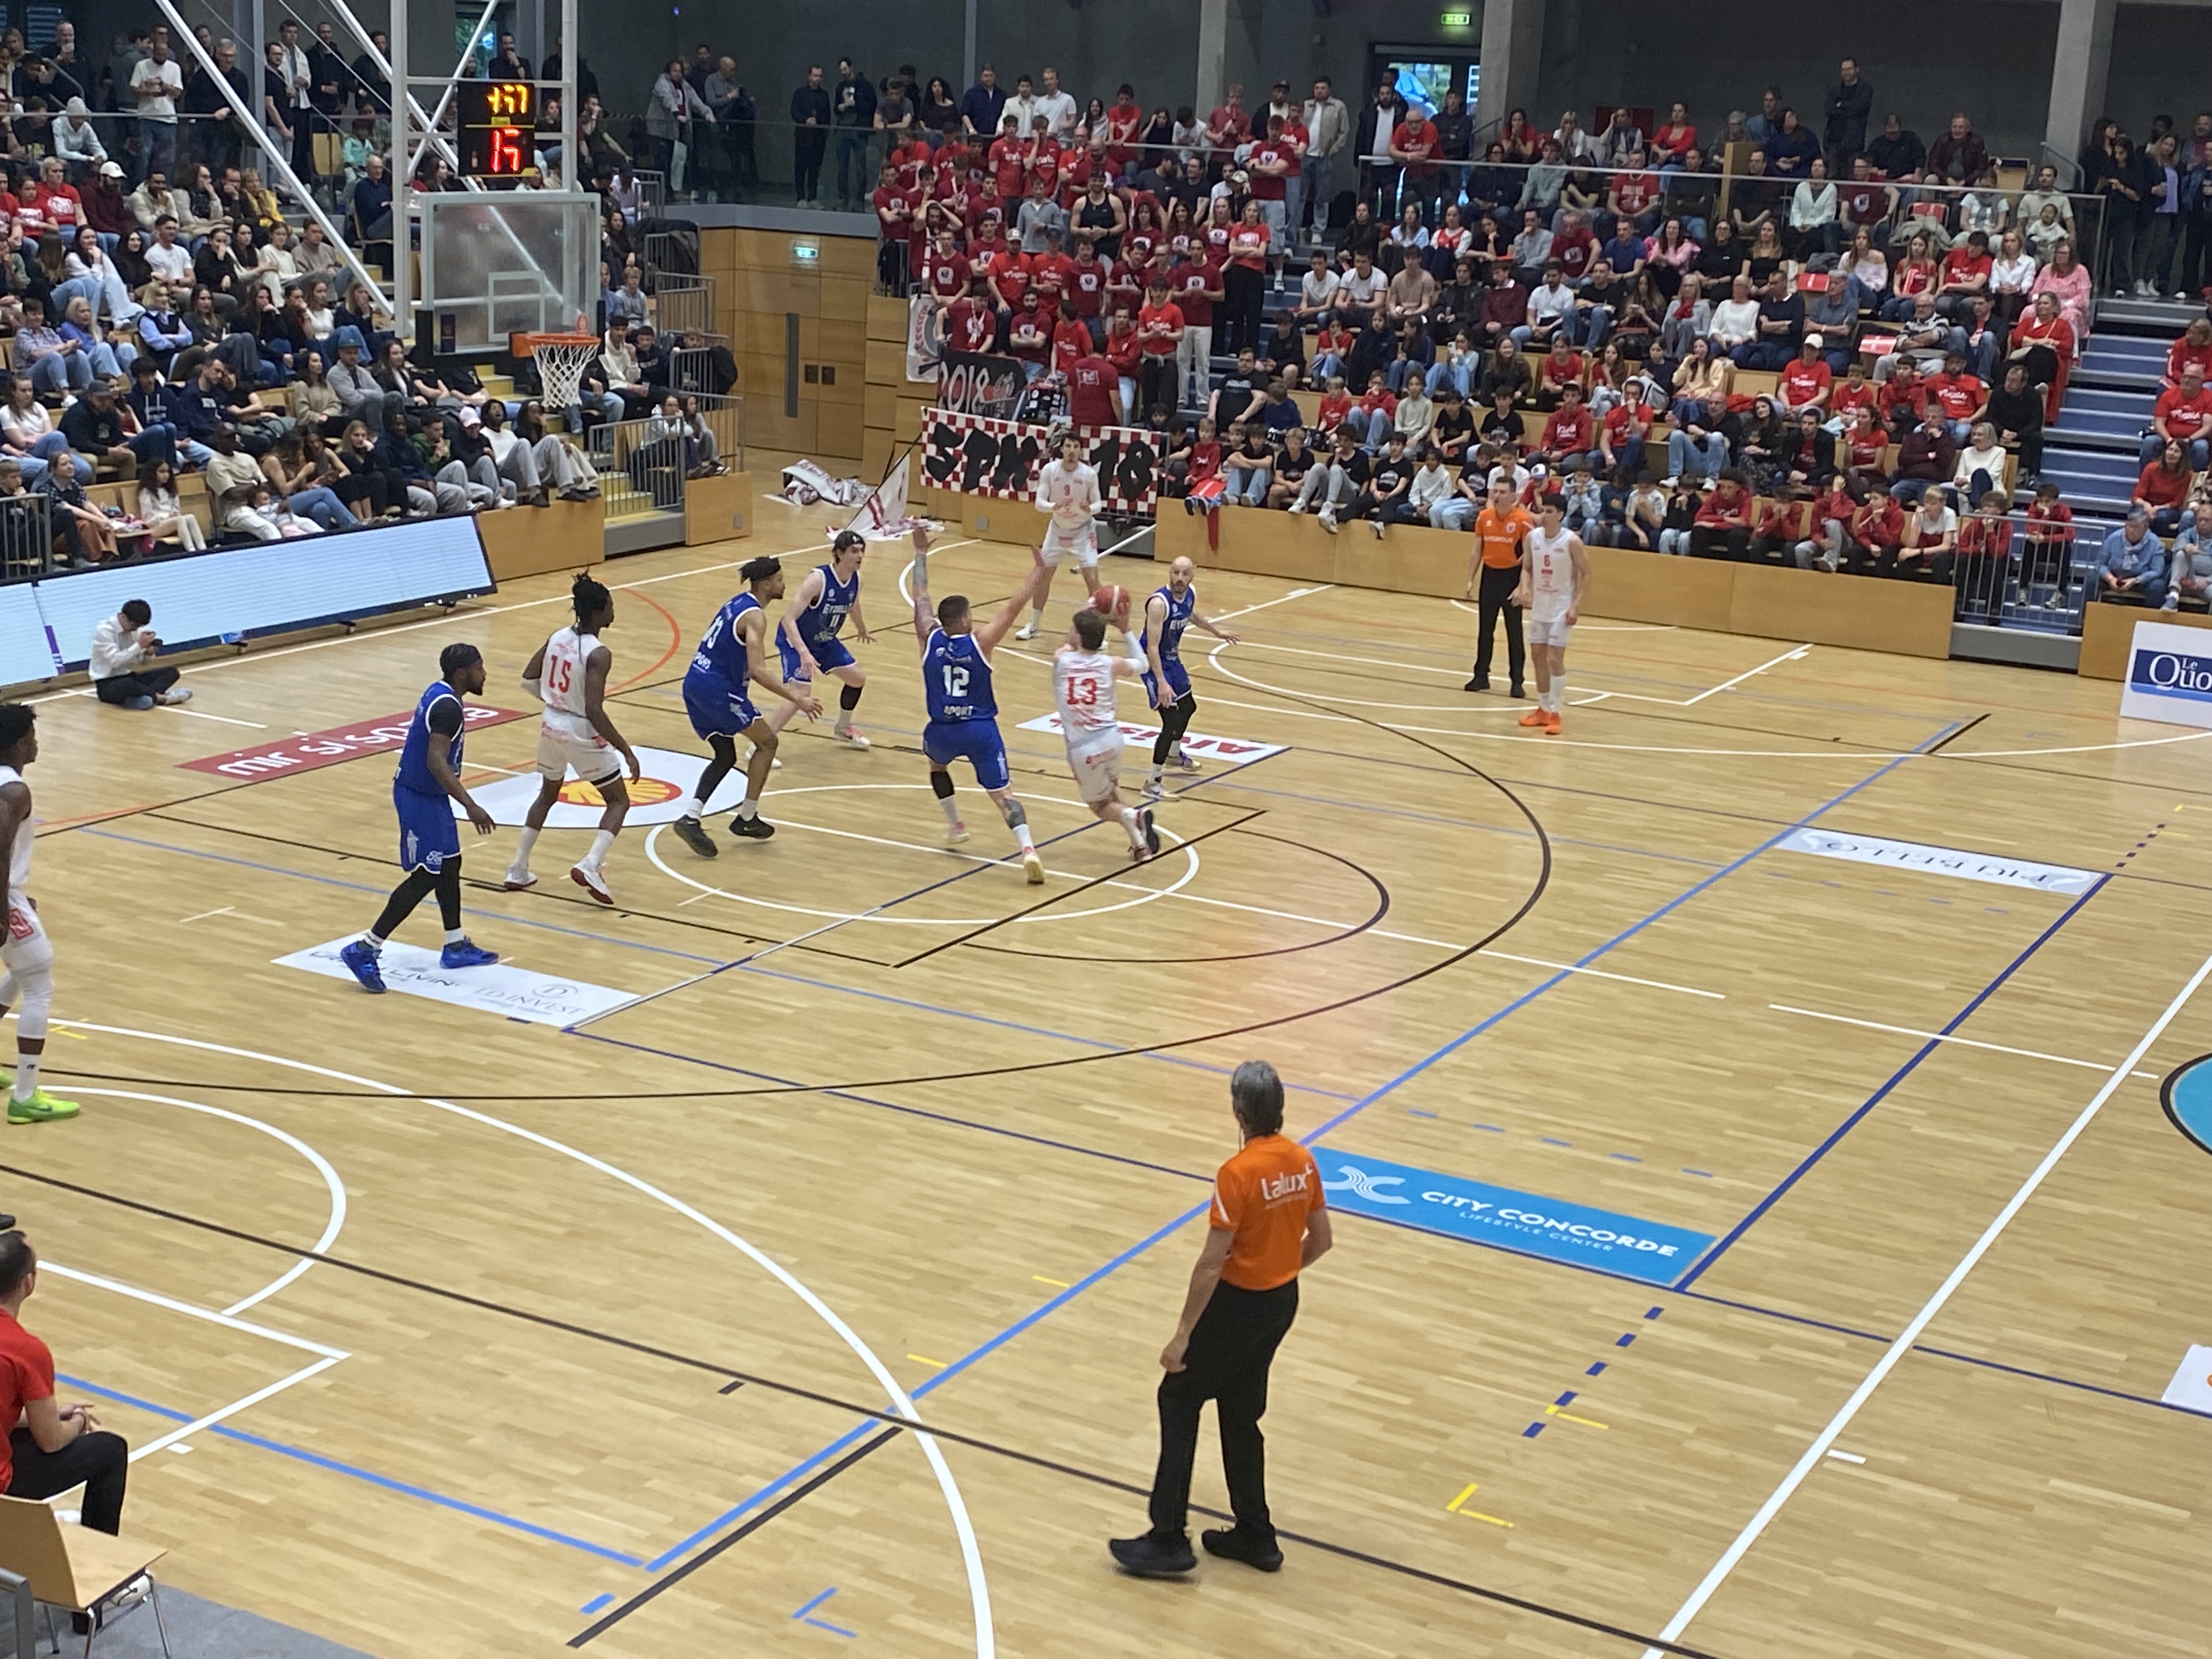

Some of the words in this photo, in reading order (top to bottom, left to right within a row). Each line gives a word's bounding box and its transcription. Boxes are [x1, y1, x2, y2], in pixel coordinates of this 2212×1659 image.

[1090, 436, 1155, 500] 18
[1544, 555, 1550, 567] 6
[549, 654, 572, 693] 15
[943, 664, 970, 697] 12
[1067, 676, 1097, 705] 13
[217, 752, 302, 776] mir
[300, 737, 358, 755] si
[1421, 1191, 1493, 1211] CITY
[1498, 1209, 1679, 1257] CONCORDE
[1459, 1211, 1543, 1235] LIFESTYLE
[1549, 1232, 1613, 1251] CENTER
